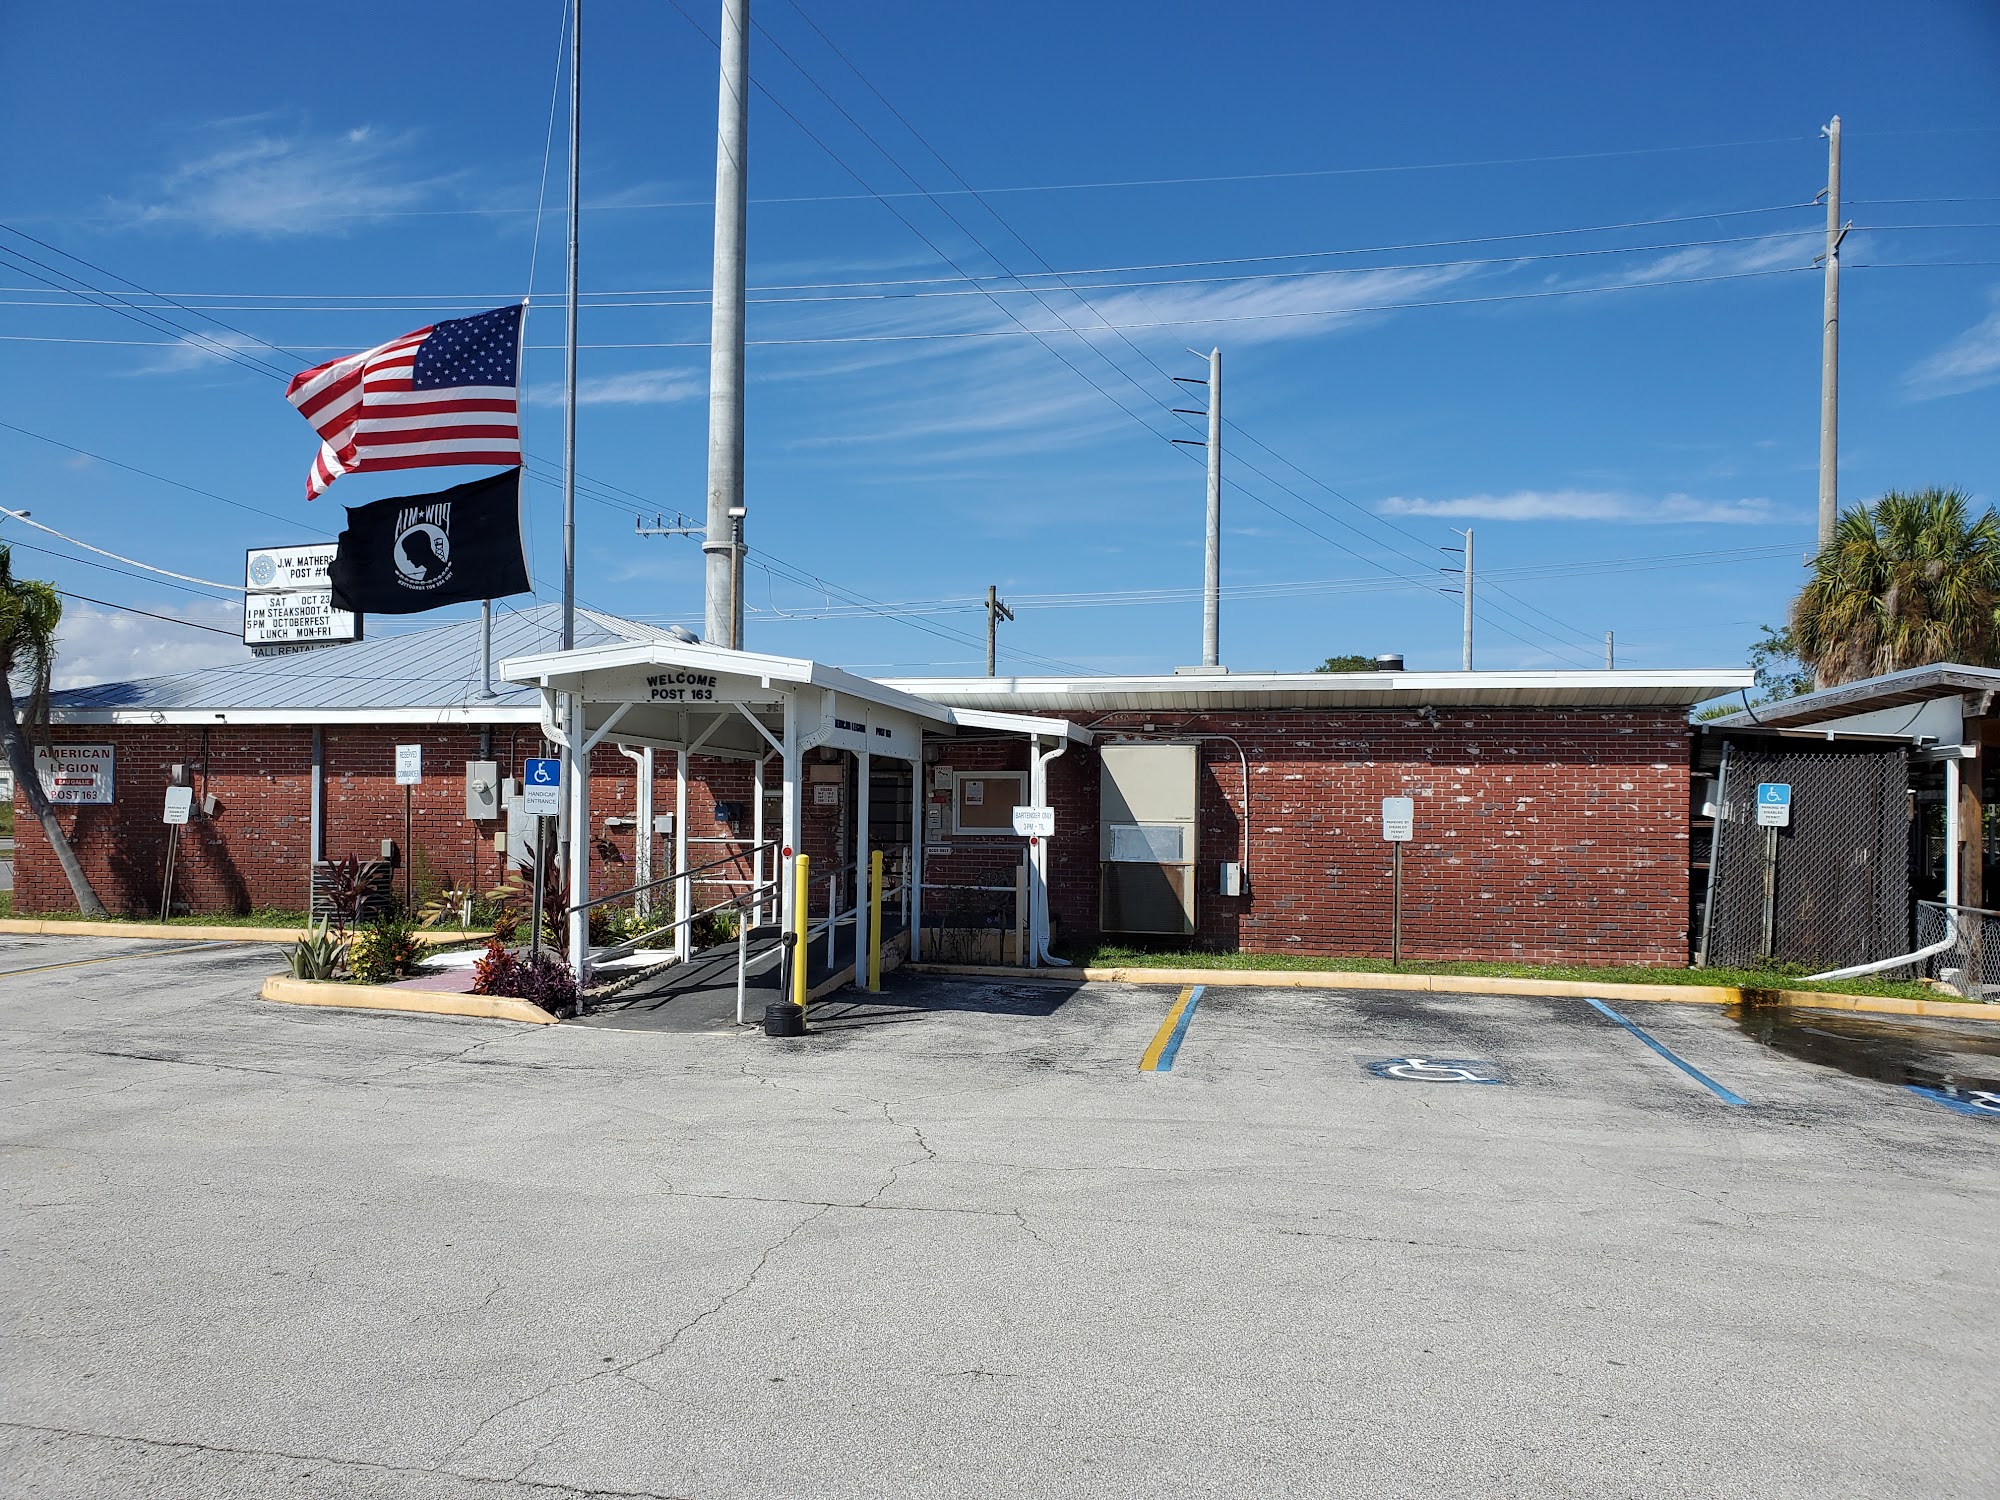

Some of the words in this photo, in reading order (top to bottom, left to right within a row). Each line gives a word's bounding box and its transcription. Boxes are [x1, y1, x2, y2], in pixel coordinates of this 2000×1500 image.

[277, 558, 295, 568] J.W.
[297, 555, 334, 567] MATHERS
[291, 568, 311, 578] POST
[269, 598, 287, 607] SAT
[301, 596, 318, 605] OCT
[320, 595, 330, 604] 23
[267, 606, 321, 618] STEAKSHOOT
[323, 606, 329, 614] 4
[272, 616, 331, 628] OCTOBERFEST
[260, 629, 288, 639] LUNCH
[296, 627, 331, 637] MON-FRI
[252, 646, 277, 658] HALL
[647, 672, 717, 687] WELCOME
[651, 689, 685, 700] POST
[691, 689, 713, 700] 163
[50, 763, 99, 773] LEGION
[51, 790, 79, 800] POST
[81, 790, 98, 800] 163
[1015, 811, 1041, 819] BARTENDER
